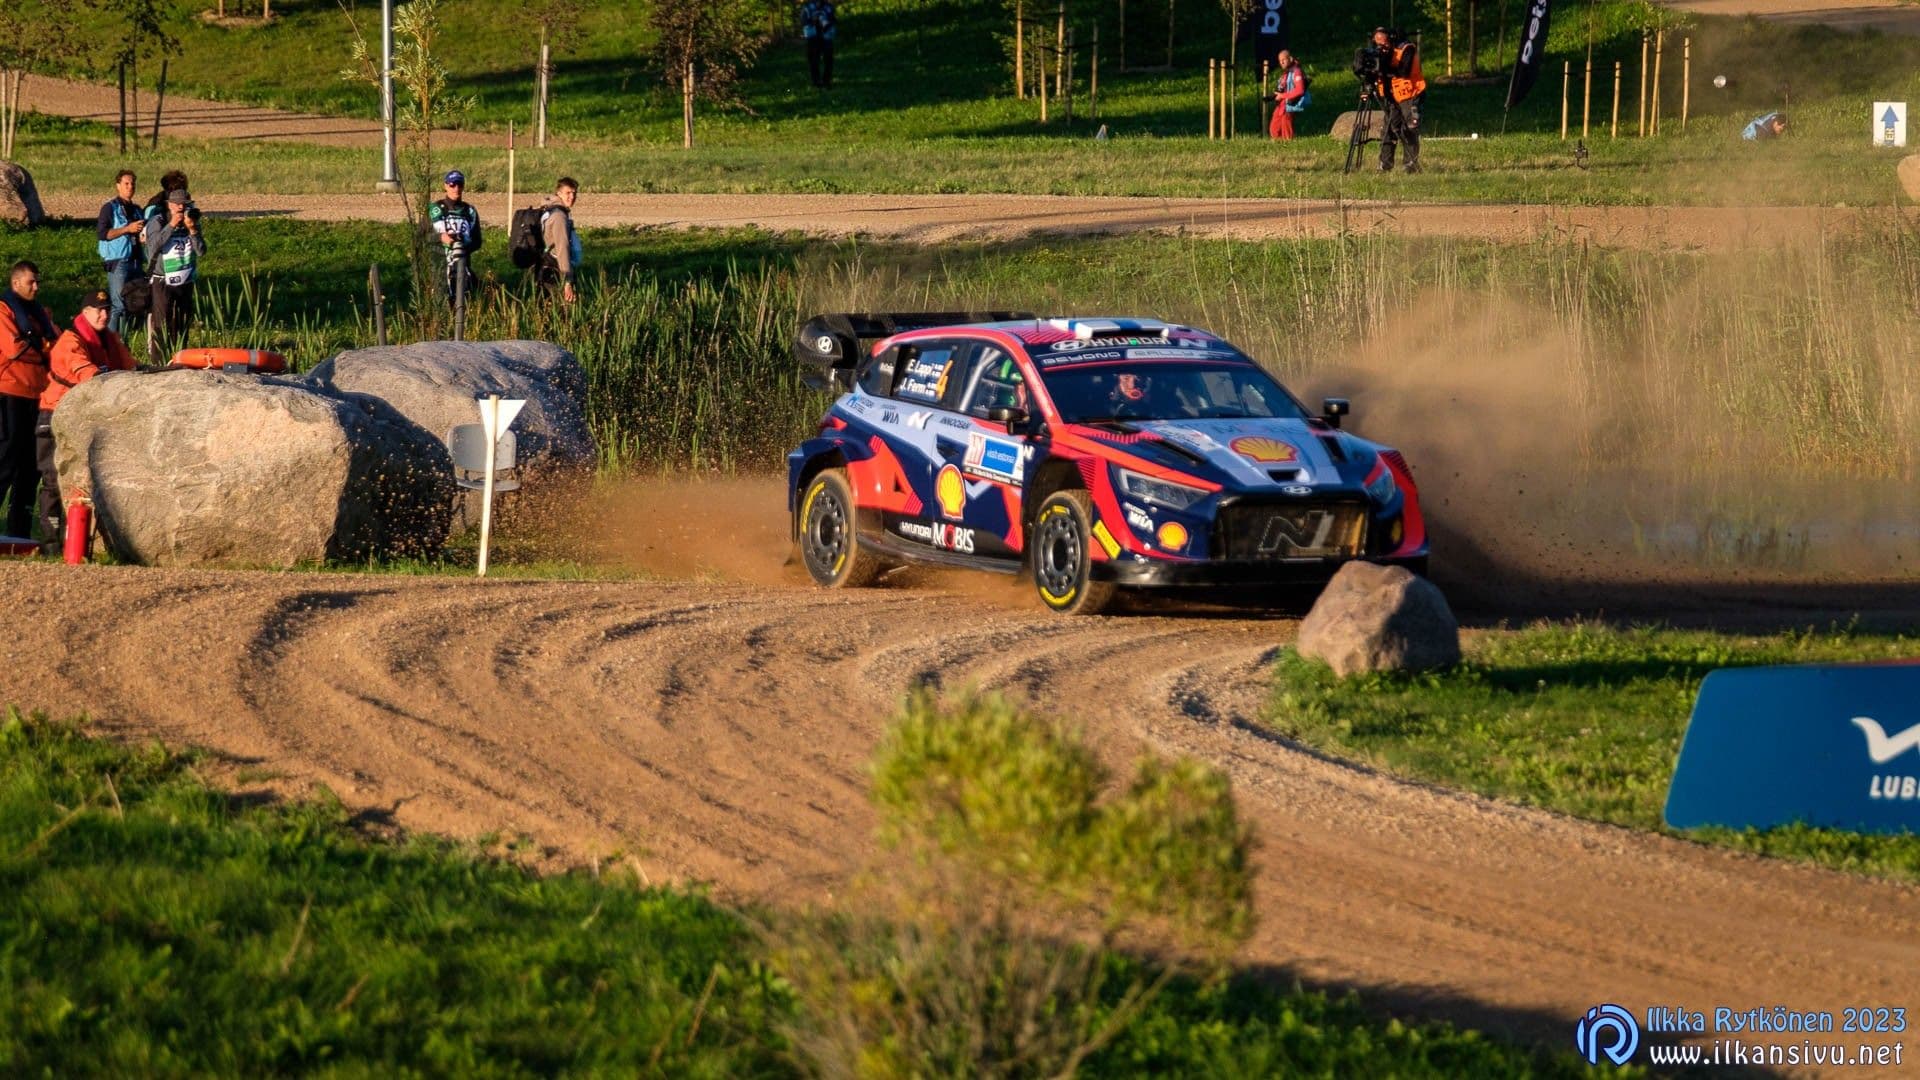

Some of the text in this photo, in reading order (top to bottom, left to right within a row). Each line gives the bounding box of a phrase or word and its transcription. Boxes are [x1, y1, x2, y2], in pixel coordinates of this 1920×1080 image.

[1042, 351, 1121, 365] BEYOND
[901, 521, 975, 553] HYUNDAI MOBIS
[1870, 775, 1920, 798] LUB
